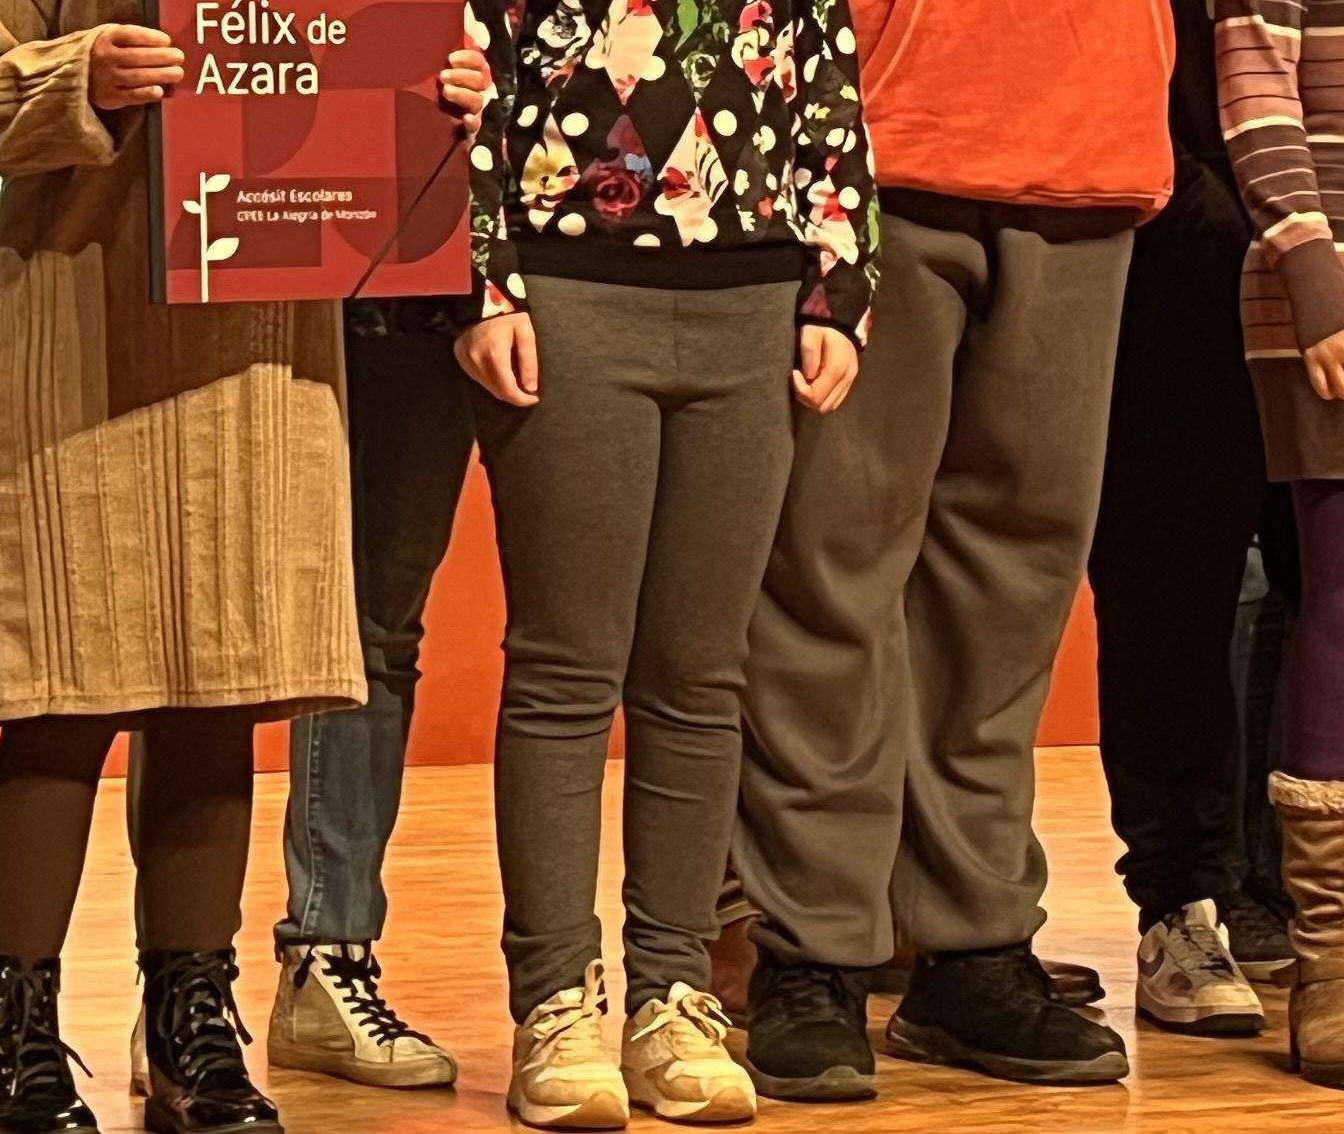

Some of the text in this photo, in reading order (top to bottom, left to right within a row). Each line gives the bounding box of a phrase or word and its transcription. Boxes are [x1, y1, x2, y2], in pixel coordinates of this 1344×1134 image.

[306, 12, 347, 45] de
[195, 53, 319, 95] Azara
[289, 188, 353, 203] Escolares
